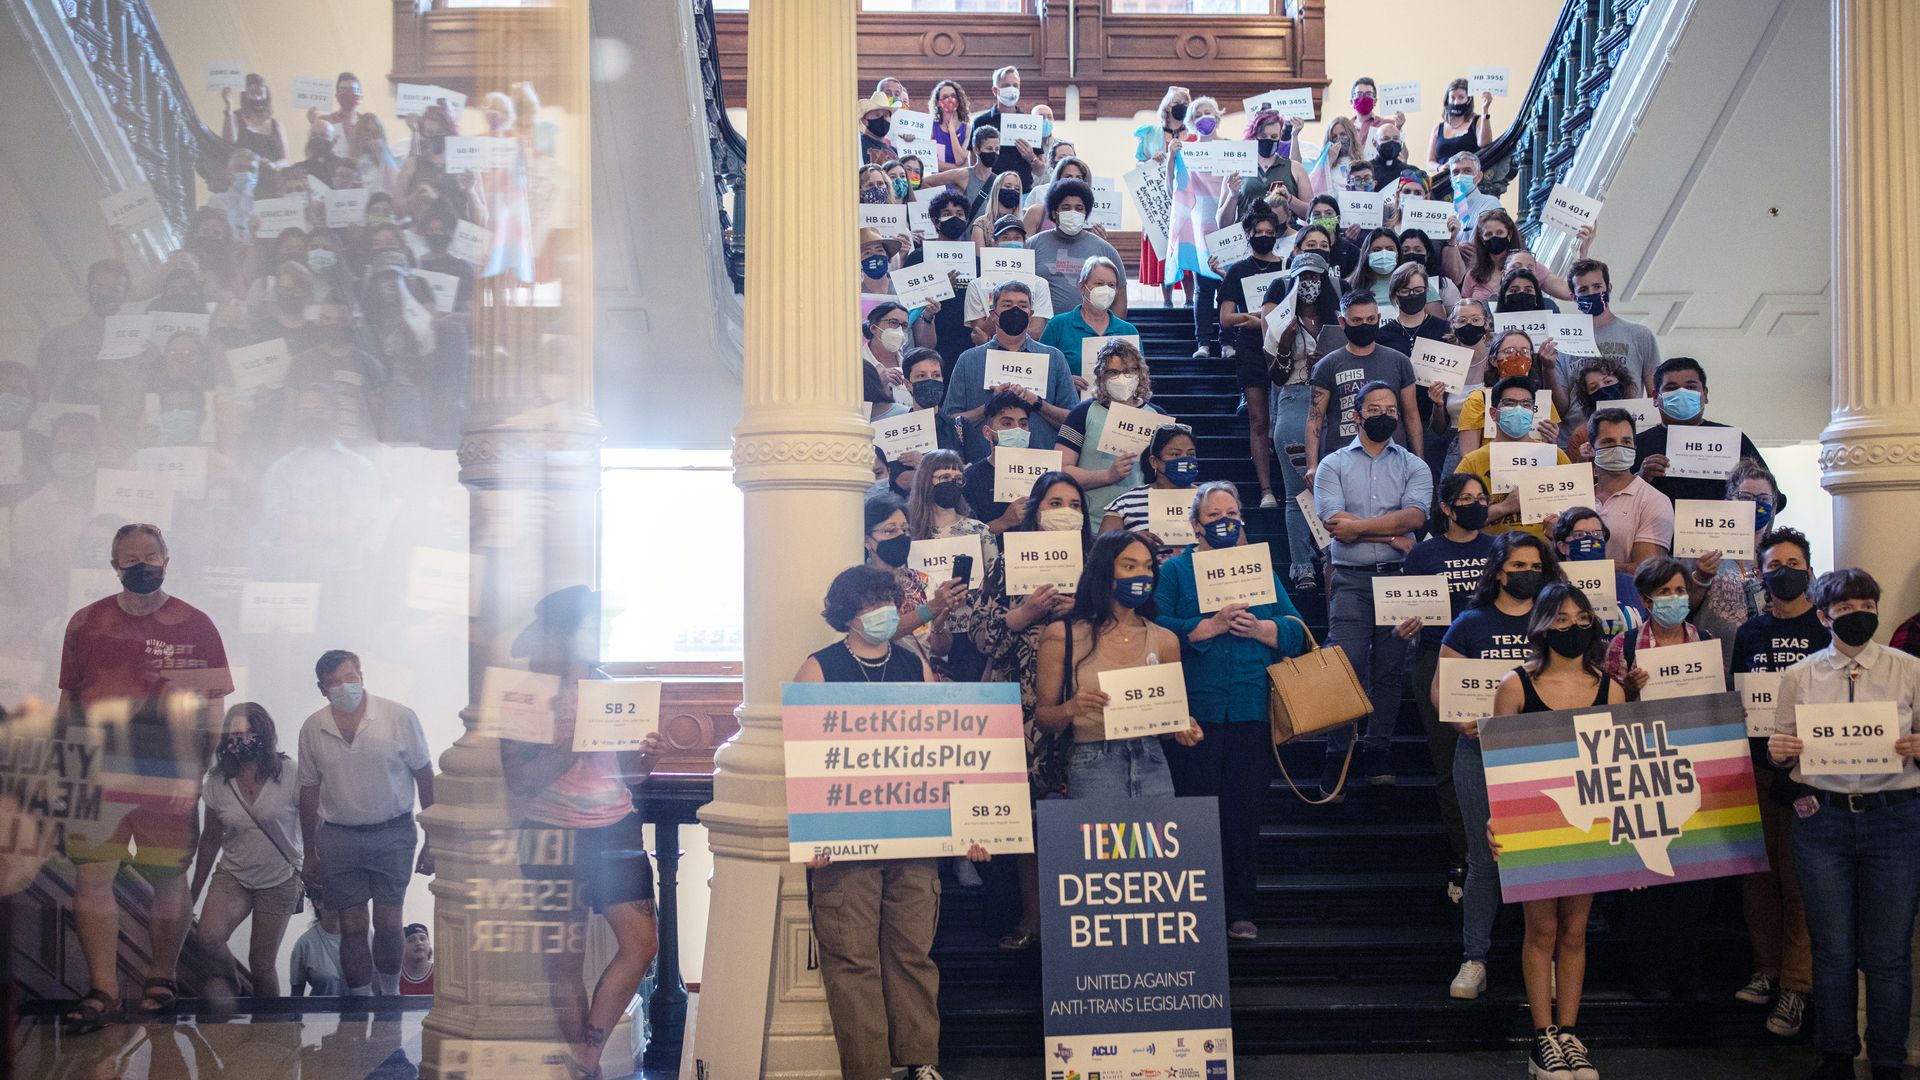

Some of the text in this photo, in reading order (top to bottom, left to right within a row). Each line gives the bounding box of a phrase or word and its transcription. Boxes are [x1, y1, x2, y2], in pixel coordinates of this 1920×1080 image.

[910, 121, 924, 129] 738
[1554, 198, 1590, 218] HB 4014
[866, 216, 898, 224] HB 610
[1426, 212, 1448, 220] 2693
[1218, 233, 1244, 246] HB 22
[952, 252, 964, 260] 90
[995, 260, 1007, 268] SB
[908, 274, 934, 288] SB 18
[1520, 322, 1546, 332] 1424
[1560, 328, 1584, 336] SB 22
[1422, 353, 1459, 368] HB 217
[1002, 364, 1032, 374] HJR 6
[1336, 370, 1363, 382] THIS
[884, 424, 922, 438] SB 551
[1118, 420, 1134, 432] HB
[1686, 442, 1722, 452] HB 10
[1512, 457, 1538, 466] SB 3
[1008, 464, 1048, 476] HB 187
[1538, 482, 1574, 493] SB 39
[1166, 506, 1184, 516] HB
[1696, 518, 1736, 528] HB 26
[924, 556, 948, 567] HJR
[1021, 550, 1068, 561] HB 100
[1206, 562, 1262, 580] HB 1458
[1578, 579, 1601, 590] 369
[1385, 589, 1438, 598] SB 1148
[1660, 662, 1702, 677] HB 25
[1462, 678, 1480, 689] SB
[1124, 686, 1165, 701] SB 28
[1752, 692, 1772, 703] HB
[605, 703, 636, 714] SB 2
[822, 708, 989, 736] #LetKidsPlay
[1812, 724, 1884, 738] SB 1206
[1578, 721, 1679, 766] Y'ALL
[824, 744, 992, 770] #LetKidsPlay
[1576, 758, 1695, 806] MEANS
[972, 805, 1011, 816] SB 29
[1612, 800, 1680, 842] ALL
[1080, 821, 1180, 860] TEXANS
[814, 844, 879, 858] EQUALITY
[1058, 870, 1208, 906] DESERVE
[1070, 911, 1200, 948] BETTER
[1076, 970, 1196, 992] UNITED AGAINST
[1050, 994, 1224, 1016] ANTI-TRANS LEGISLATION
[1092, 1044, 1118, 1056] ACLU
